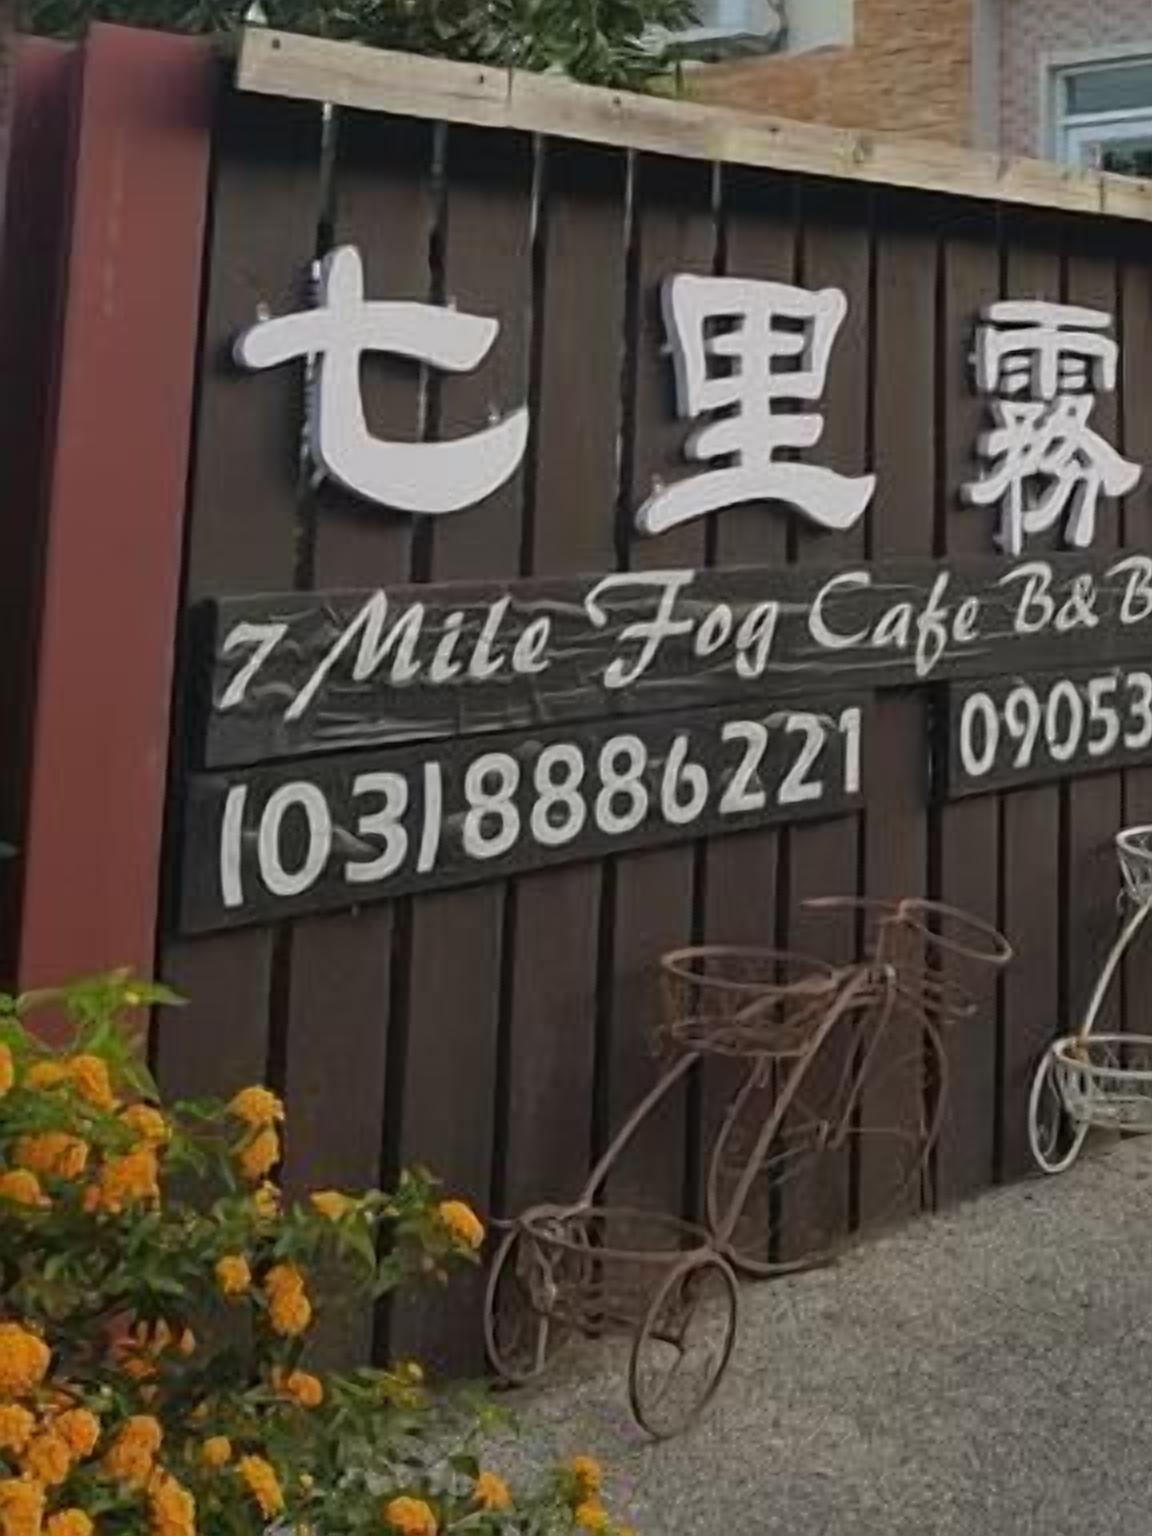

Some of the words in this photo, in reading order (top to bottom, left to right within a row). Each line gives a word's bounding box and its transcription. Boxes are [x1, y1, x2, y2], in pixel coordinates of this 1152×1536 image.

[236, 243, 1142, 555] 七里霧
[217, 621, 288, 711] 7
[283, 589, 552, 722] Mile
[584, 569, 780, 689] Fog
[808, 571, 979, 677] Cafe
